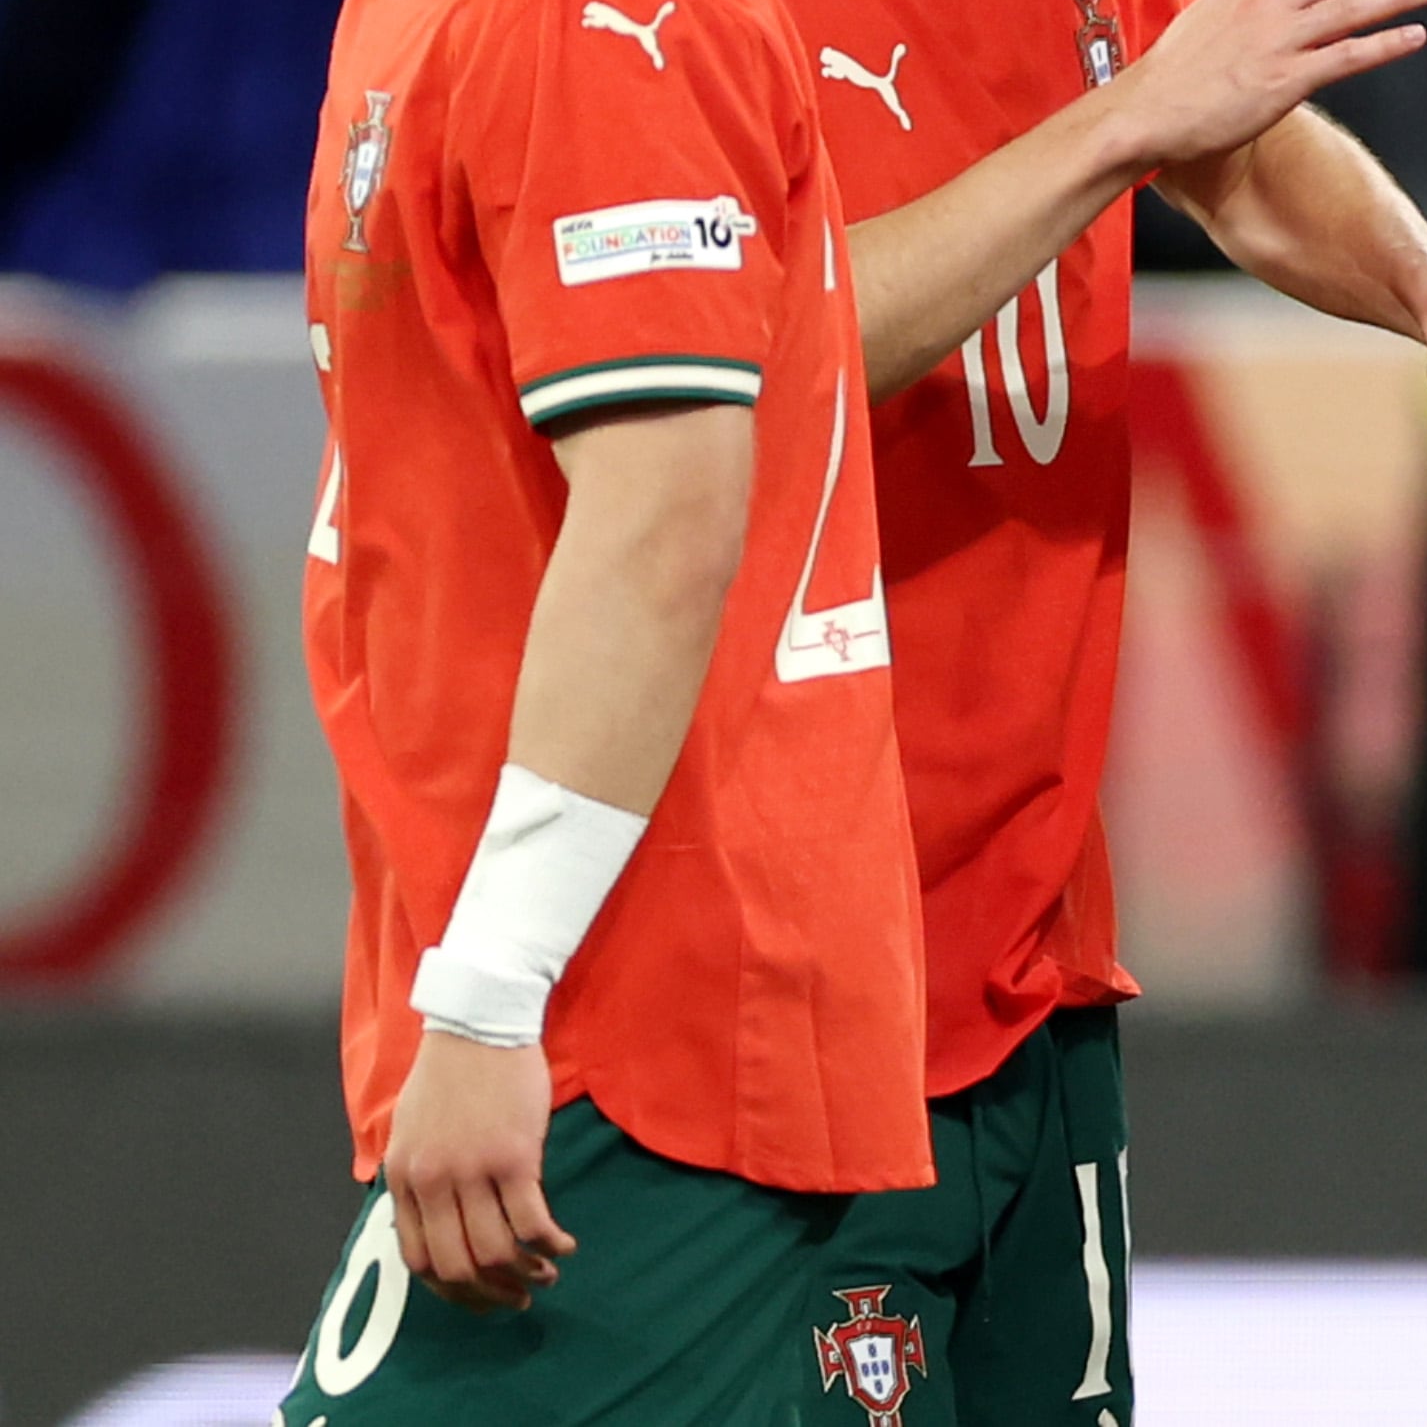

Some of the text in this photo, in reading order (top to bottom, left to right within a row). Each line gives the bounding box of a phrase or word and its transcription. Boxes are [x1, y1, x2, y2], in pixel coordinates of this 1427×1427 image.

[563, 225, 693, 259] FOUNDATION
[694, 216, 732, 249] 10
[961, 257, 1070, 468] 10
